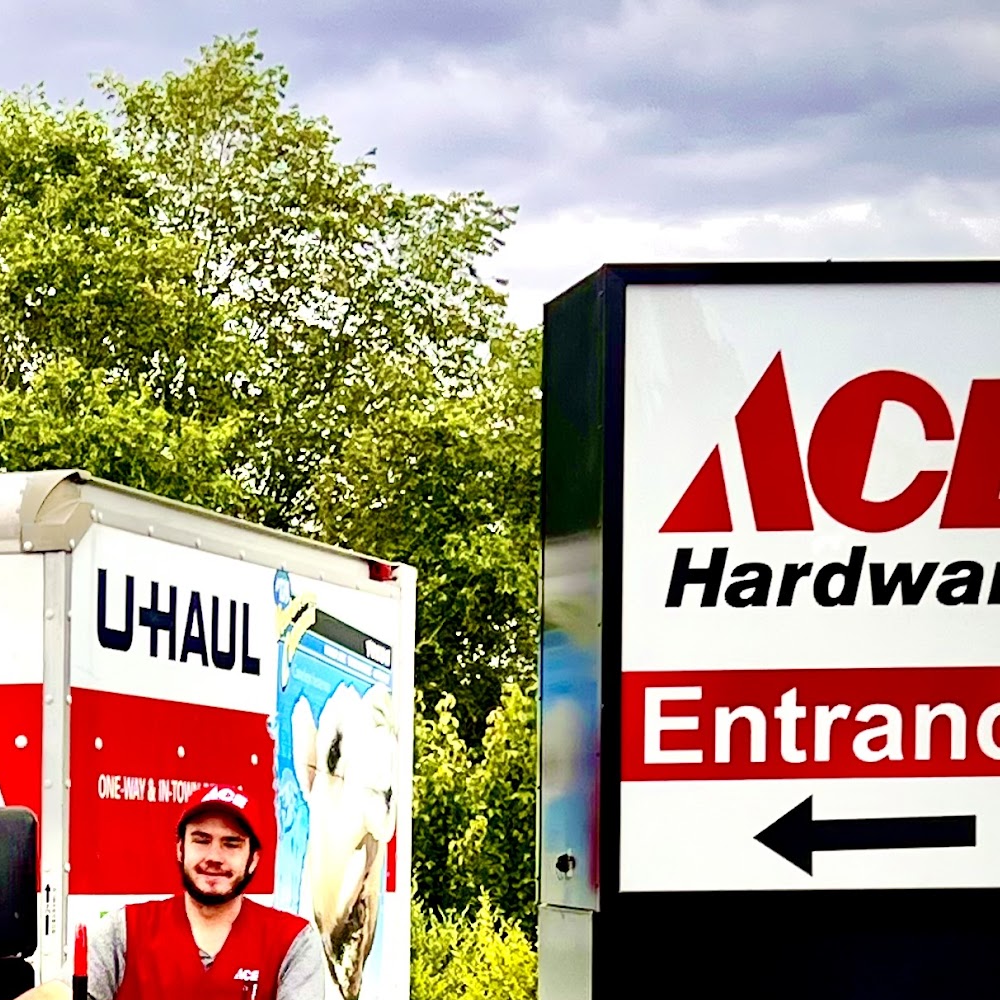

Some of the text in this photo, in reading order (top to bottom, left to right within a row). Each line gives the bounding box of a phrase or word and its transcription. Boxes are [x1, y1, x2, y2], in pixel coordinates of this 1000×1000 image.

[97, 568, 261, 677] U-HAUL
[98, 773, 146, 801] ONE-WAY
[147, 777, 157, 803] &
